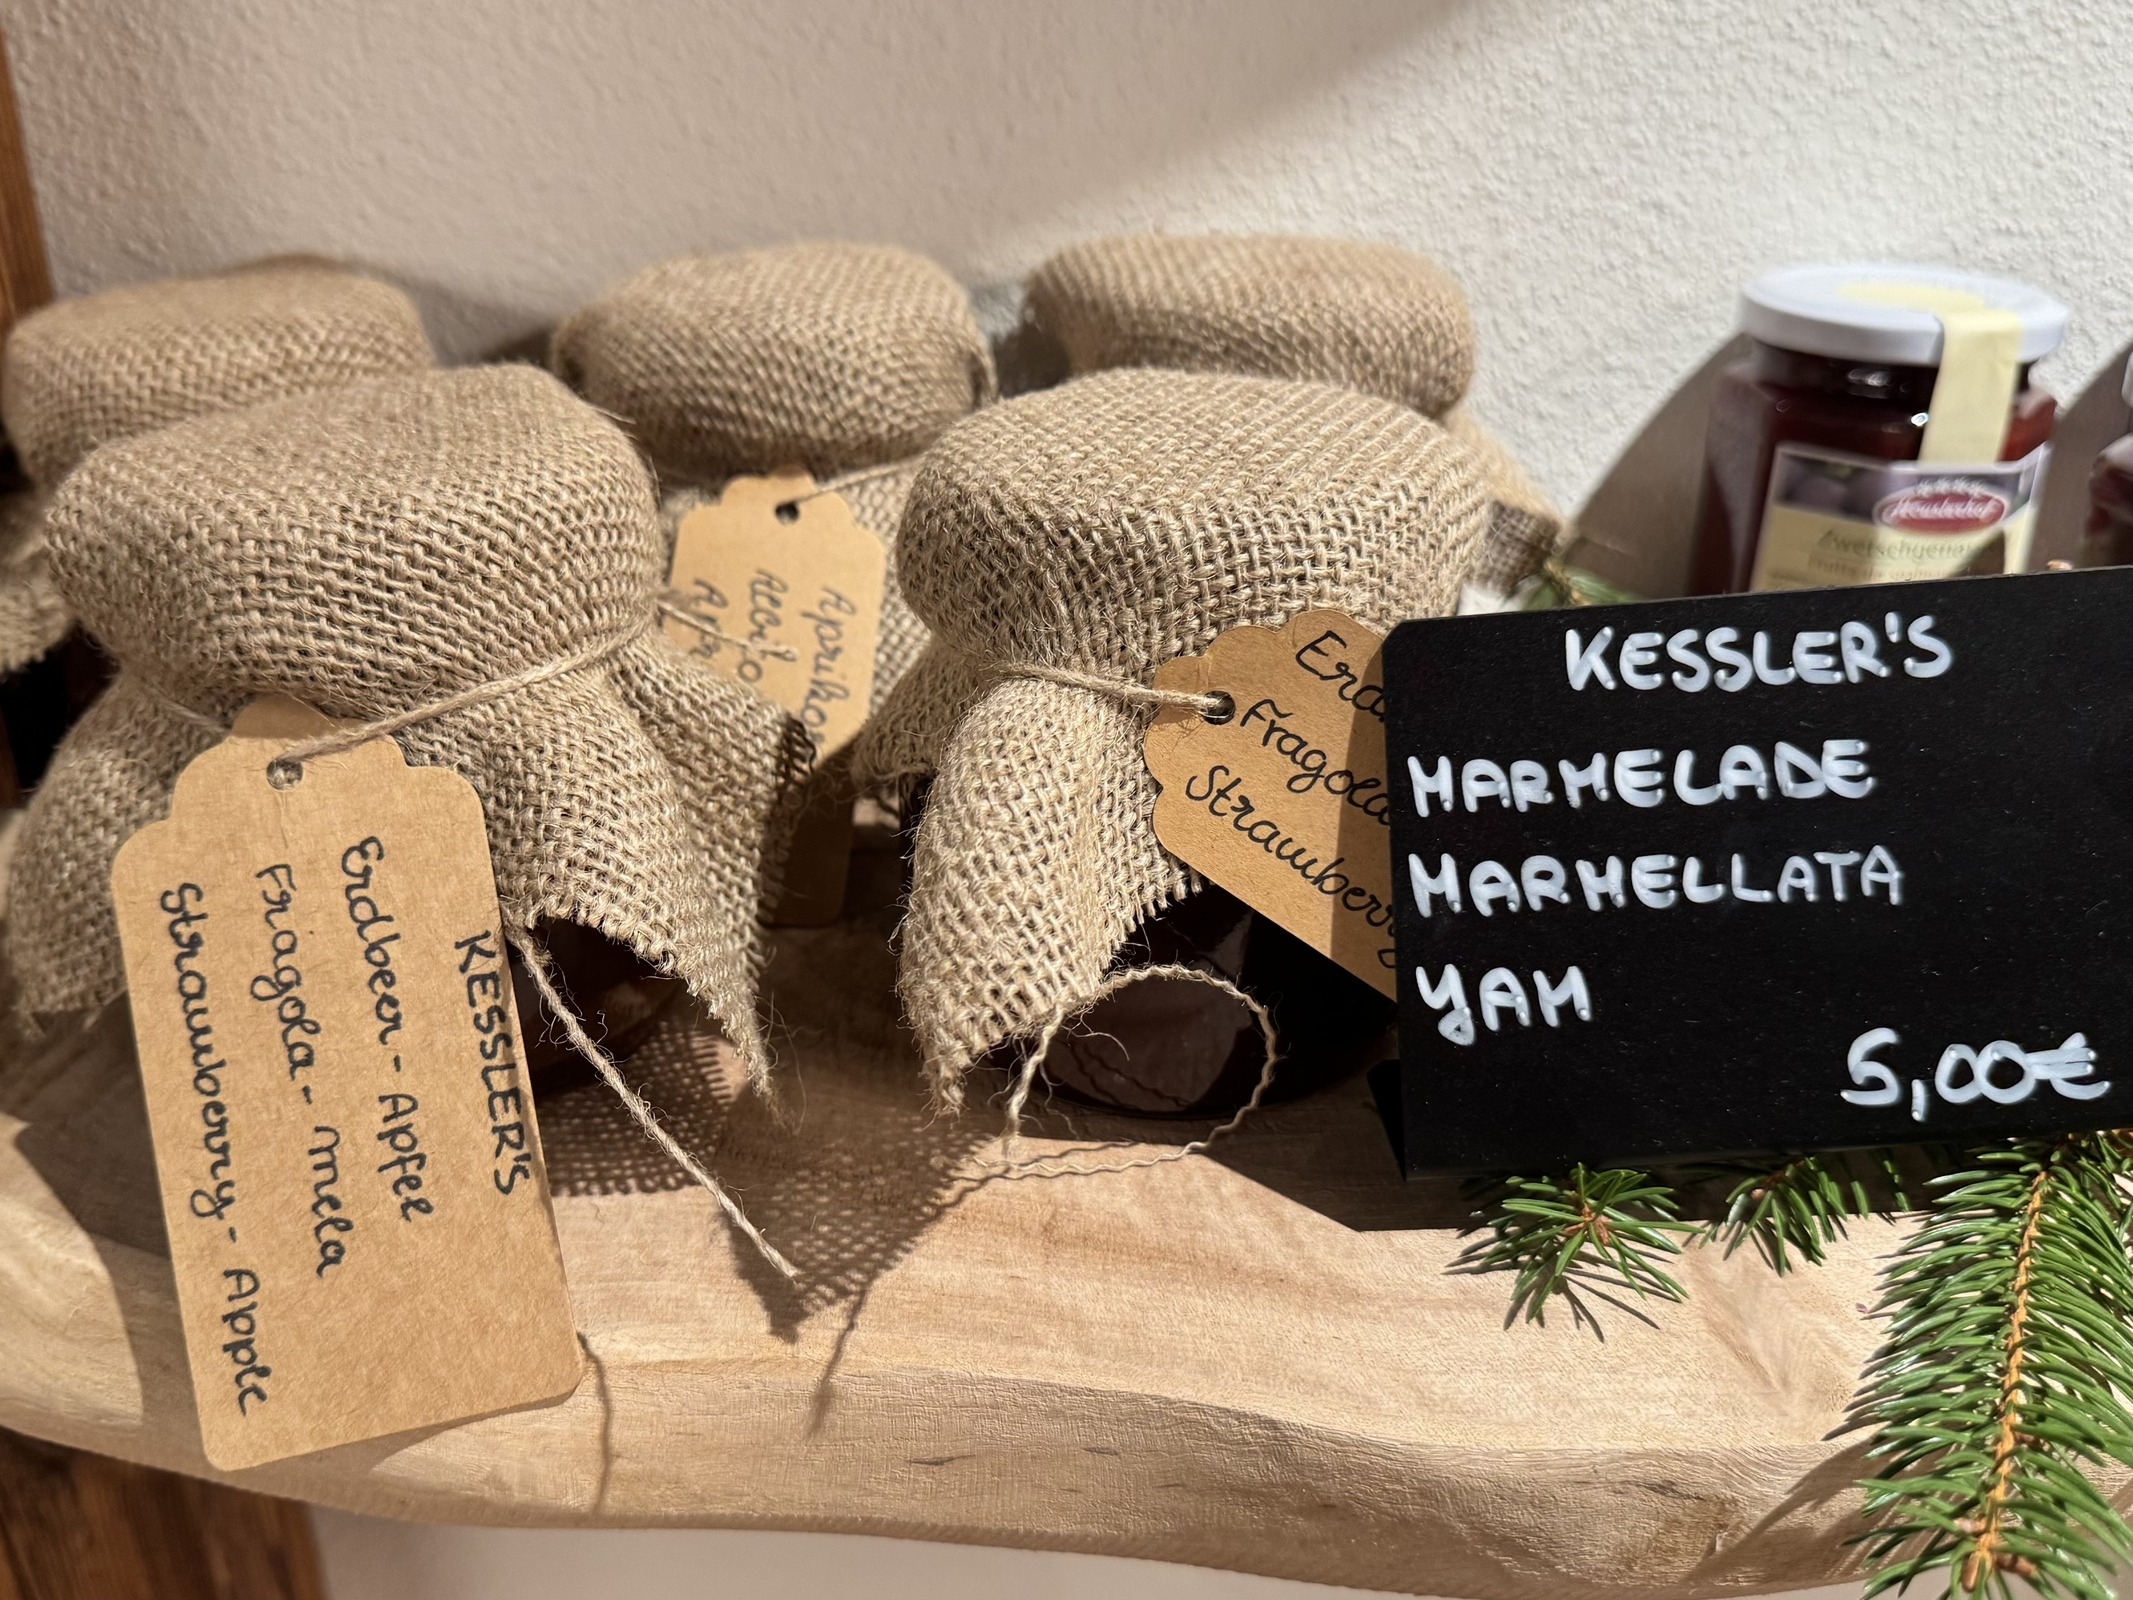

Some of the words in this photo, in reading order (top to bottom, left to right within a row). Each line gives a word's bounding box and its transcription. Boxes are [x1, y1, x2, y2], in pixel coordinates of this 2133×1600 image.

[1565, 612, 1953, 692] KESSLER'S
[1407, 740, 1875, 818] MARMELADE
[1185, 764, 1396, 969] Strawber
[1408, 845, 1903, 918] MARMELLATA
[249, 862, 322, 1083] Fragola
[340, 835, 403, 1047] Erdbeer
[377, 1092, 435, 1224] Apfel
[1416, 963, 1592, 1046] YAM
[454, 929, 532, 1197] KESSLER'S
[1841, 1028, 2112, 1121] 5,00€
[159, 882, 237, 1222] Strawberry
[221, 1267, 272, 1417] Apple
